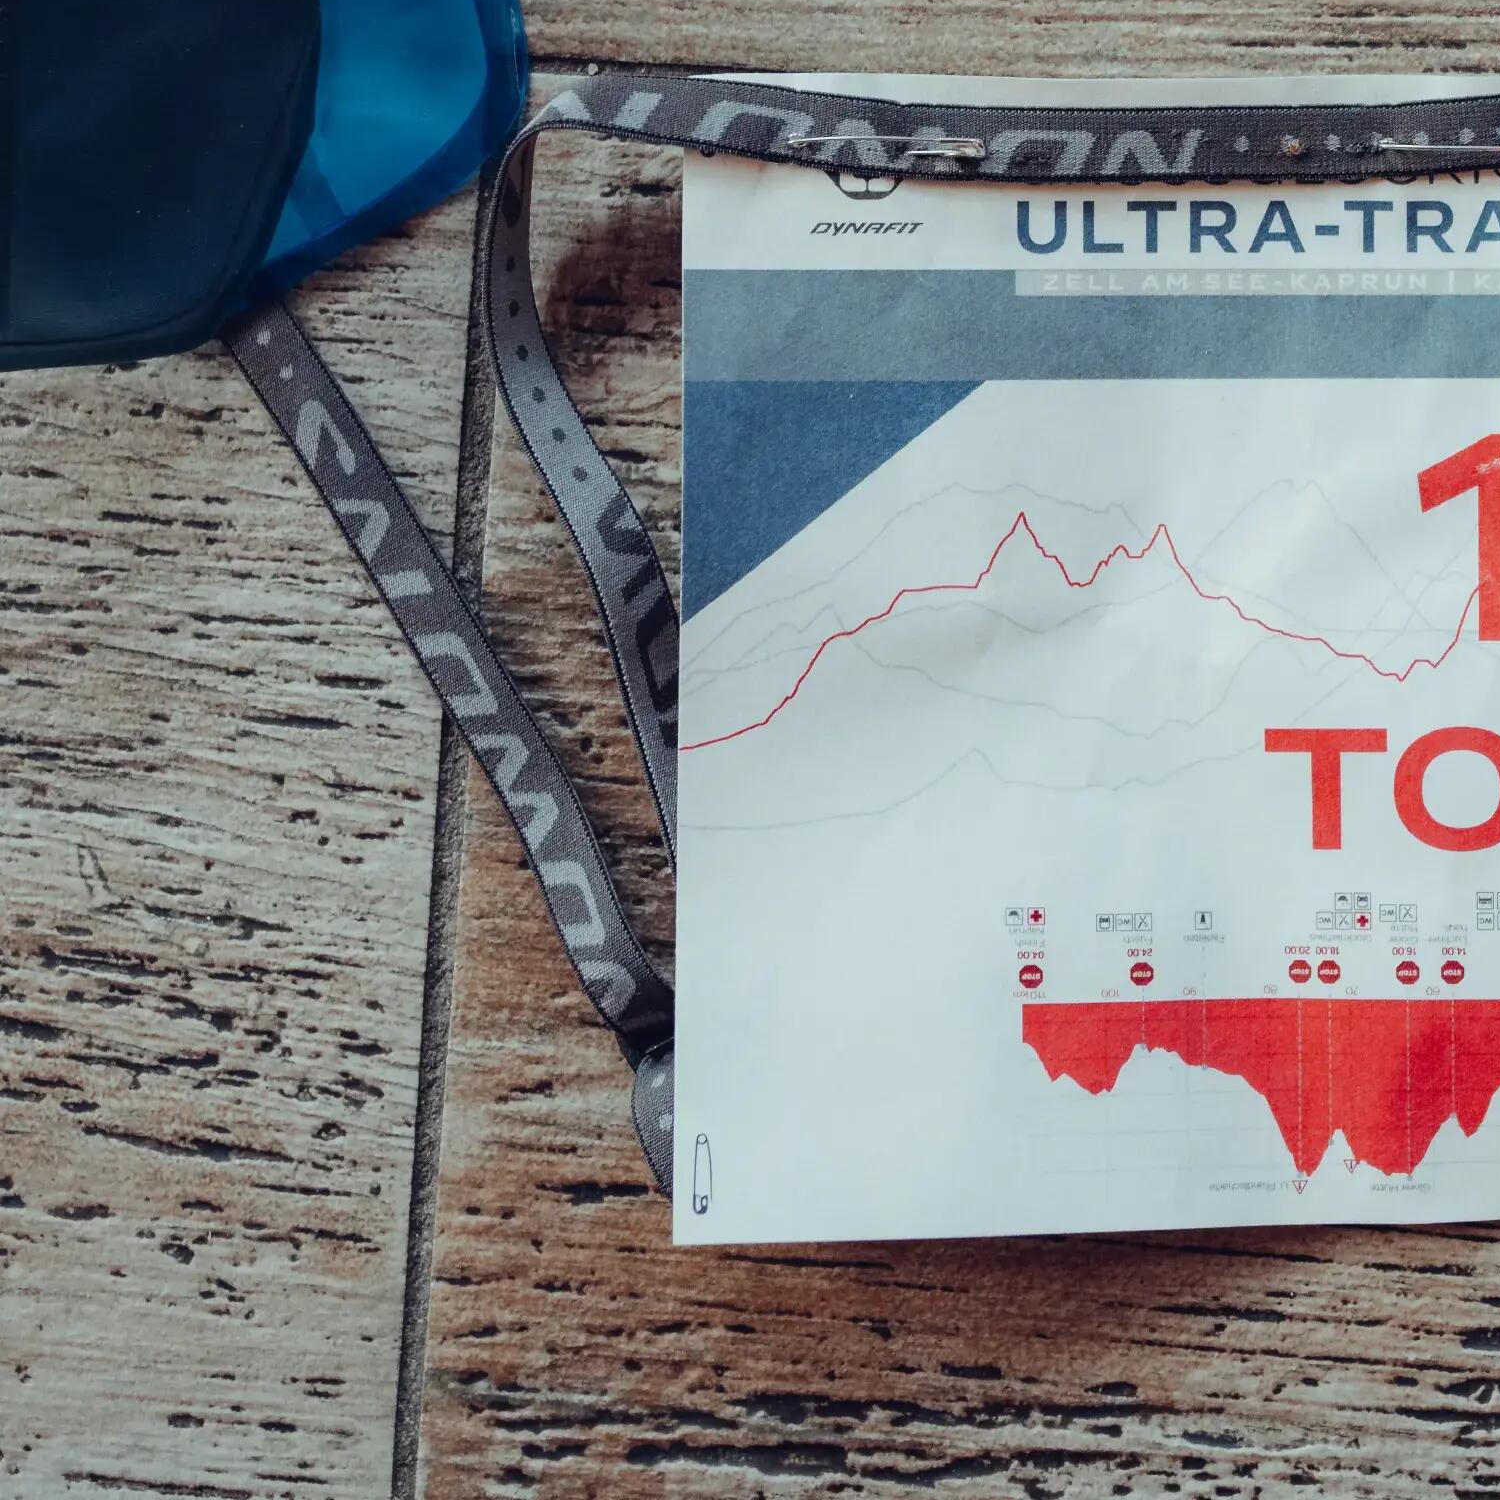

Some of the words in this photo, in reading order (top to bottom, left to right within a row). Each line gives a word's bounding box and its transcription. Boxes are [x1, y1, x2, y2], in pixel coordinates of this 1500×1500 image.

[810, 220, 924, 236] DYNAFIT
[1043, 273, 1125, 292] ZELL
[1140, 272, 1192, 293] AM
[1204, 271, 1429, 294] SEE-KAPRUN
[1126, 947, 1152, 956] 24.00
[1314, 945, 1339, 955] 18.00
[1440, 945, 1466, 955] 14.00
[1182, 986, 1196, 995] 90
[1425, 985, 1439, 995] 60
